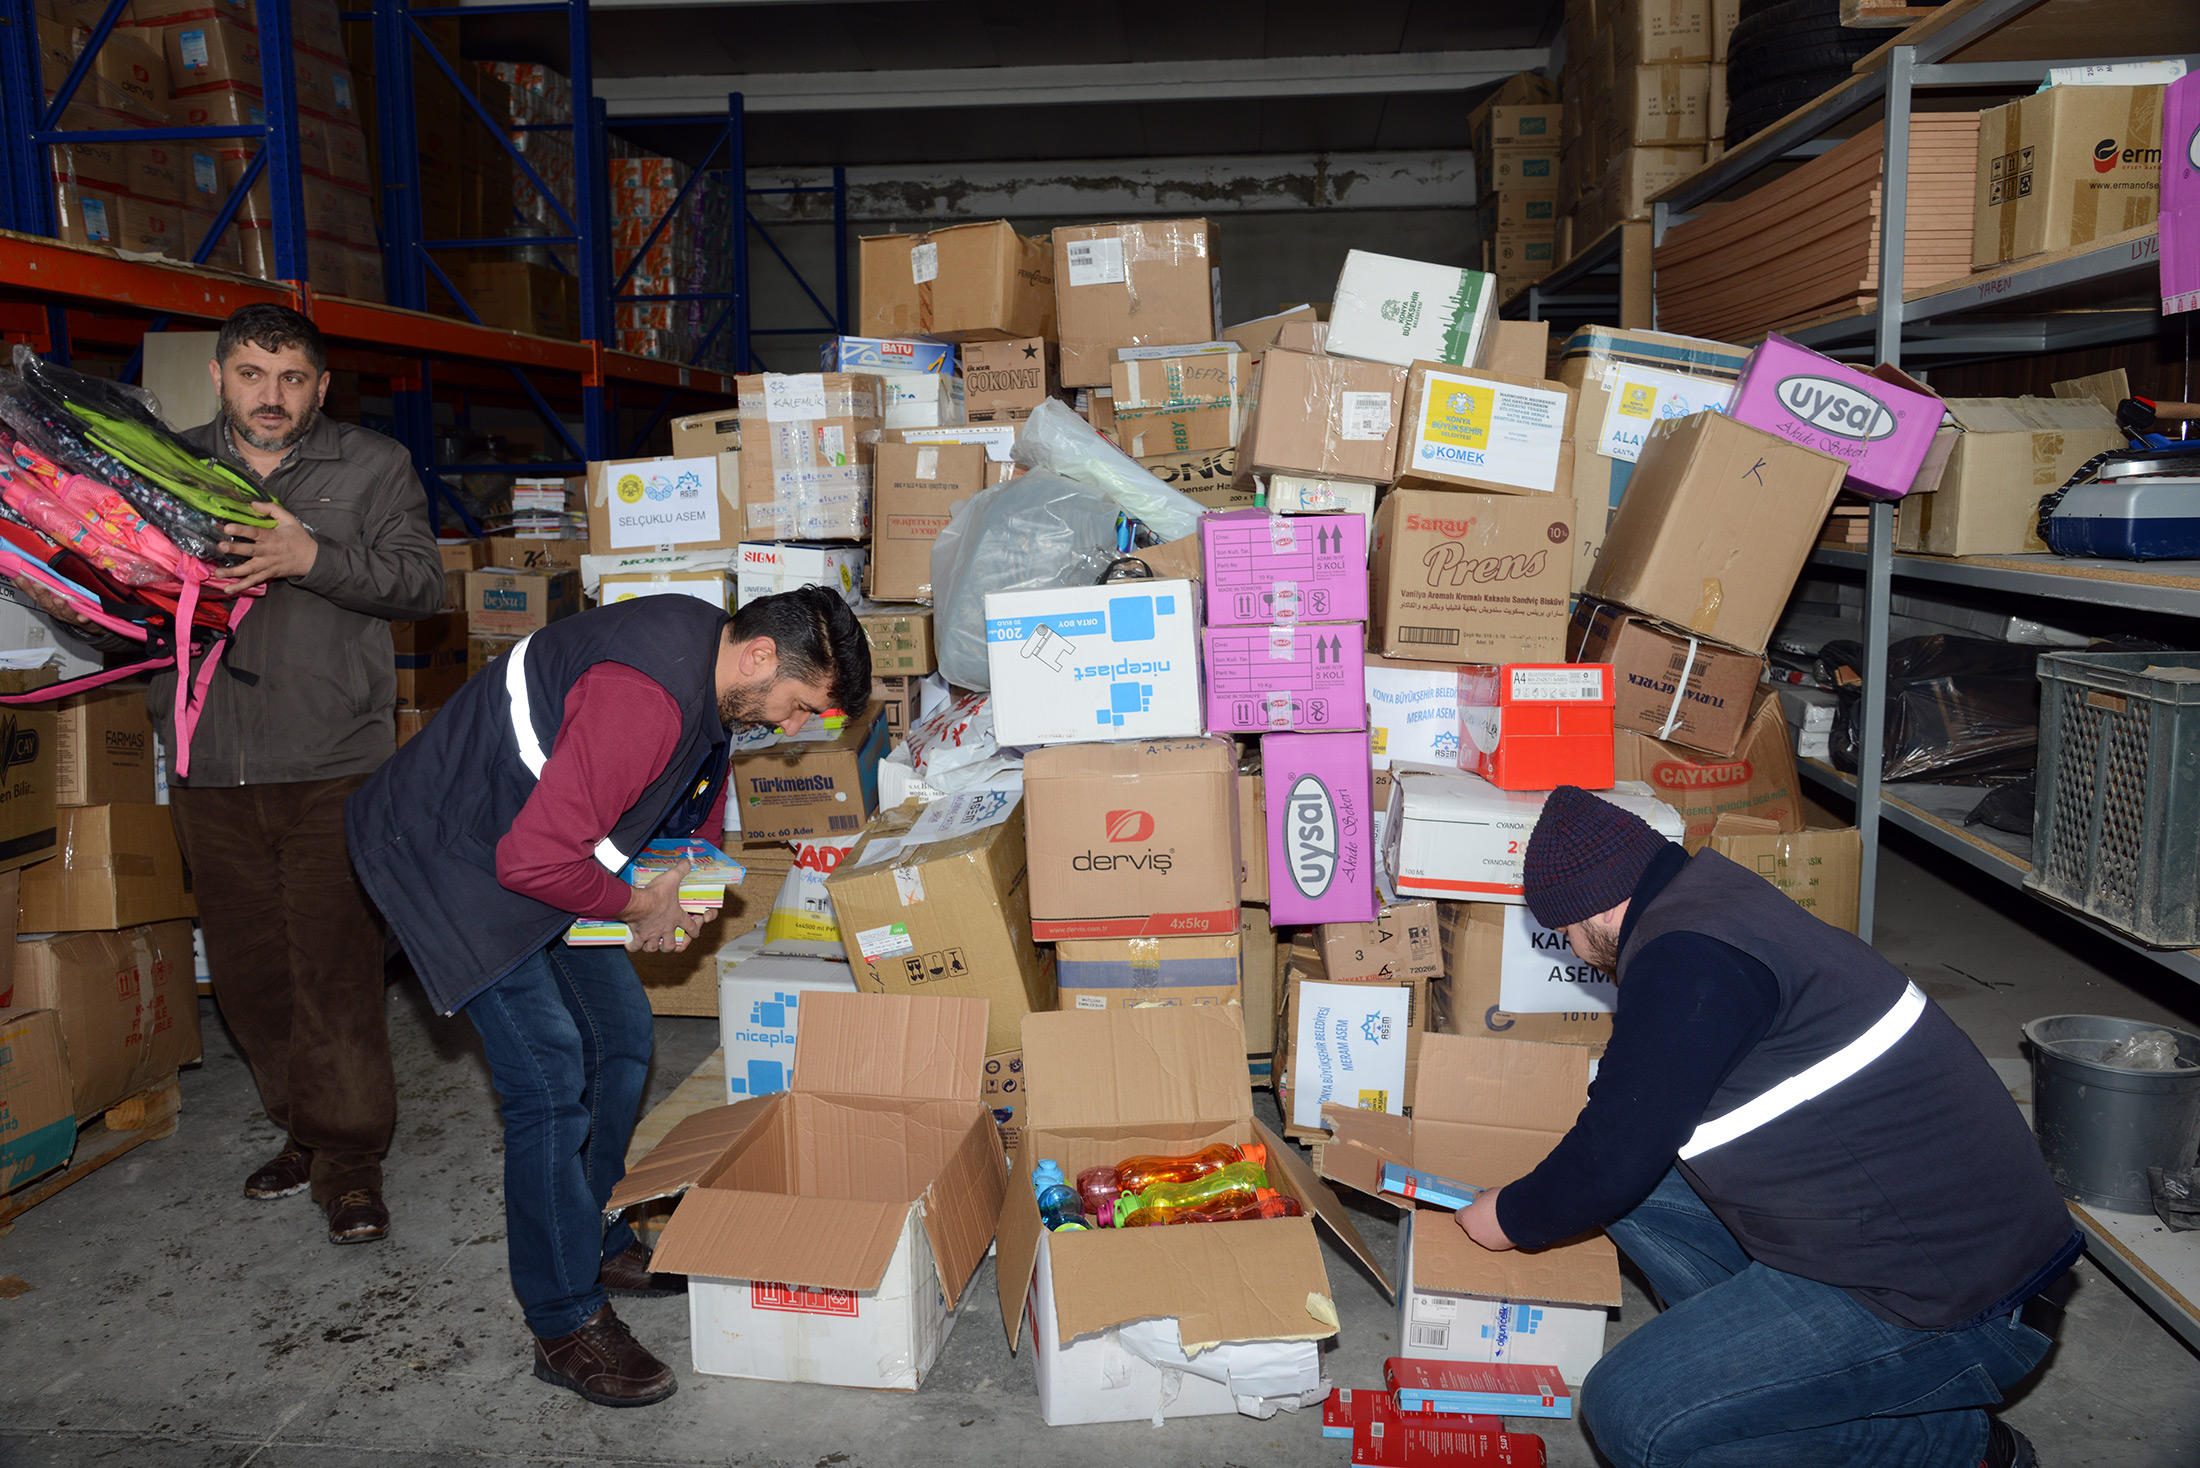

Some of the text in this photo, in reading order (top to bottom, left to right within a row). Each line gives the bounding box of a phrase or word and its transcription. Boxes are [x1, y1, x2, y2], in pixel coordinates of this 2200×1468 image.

[2122, 148, 2160, 163] erm
[2090, 181, 2160, 189] www.ermanofse
[1398, 301, 1410, 324] KONYA
[1402, 291, 1420, 337] BÜYÜKŞEHİR
[882, 343, 912, 354] BATU
[967, 368, 1040, 395] ÇOKONAT
[1186, 366, 1237, 390] DEFTER
[1786, 382, 1883, 440] uysal
[1431, 420, 1483, 437] BÜYÜKŞEHİR
[1445, 415, 1472, 426] KONYA
[1171, 421, 1189, 450] ERBY
[1436, 446, 1485, 464] KOMEK
[1180, 482, 1231, 494] penser Ha
[618, 511, 706, 527] SELÇUKLU ASEM
[1324, 561, 1345, 569] KOLİ
[1422, 541, 1548, 587] Prens
[1401, 590, 1564, 606] Vanilya Aromalı Kremalı Kakaolu Sandviç Bisküvi
[1058, 619, 1098, 628] ORTA BOY
[998, 628, 1023, 640] 200
[1074, 658, 1171, 681] niceplast
[1323, 670, 1344, 679] KOLİ
[1514, 672, 1526, 684] A4
[1627, 673, 1676, 695] GEVREK
[1372, 687, 1459, 704] KONYA BÜYÜKŞEHİR BELEDİ
[1406, 708, 1456, 724] MERAM ASEM
[750, 775, 834, 793] TürkmenSu
[1659, 766, 1746, 787] ÇAYKUR
[1686, 806, 1714, 816] GENEL
[1717, 793, 1771, 814] MÜDÜRLÜĞÜ
[747, 830, 764, 838] 200
[793, 827, 814, 836] Adet
[1286, 794, 1341, 883] uysal
[1072, 848, 1173, 875] derviş
[1405, 868, 1414, 876] 100
[1170, 917, 1210, 931] 4x5kg
[1355, 950, 1364, 961] 3
[1410, 965, 1436, 974] 720266
[736, 1029, 795, 1047] nicepla
[1337, 1019, 1354, 1072] MERAM ASEM
